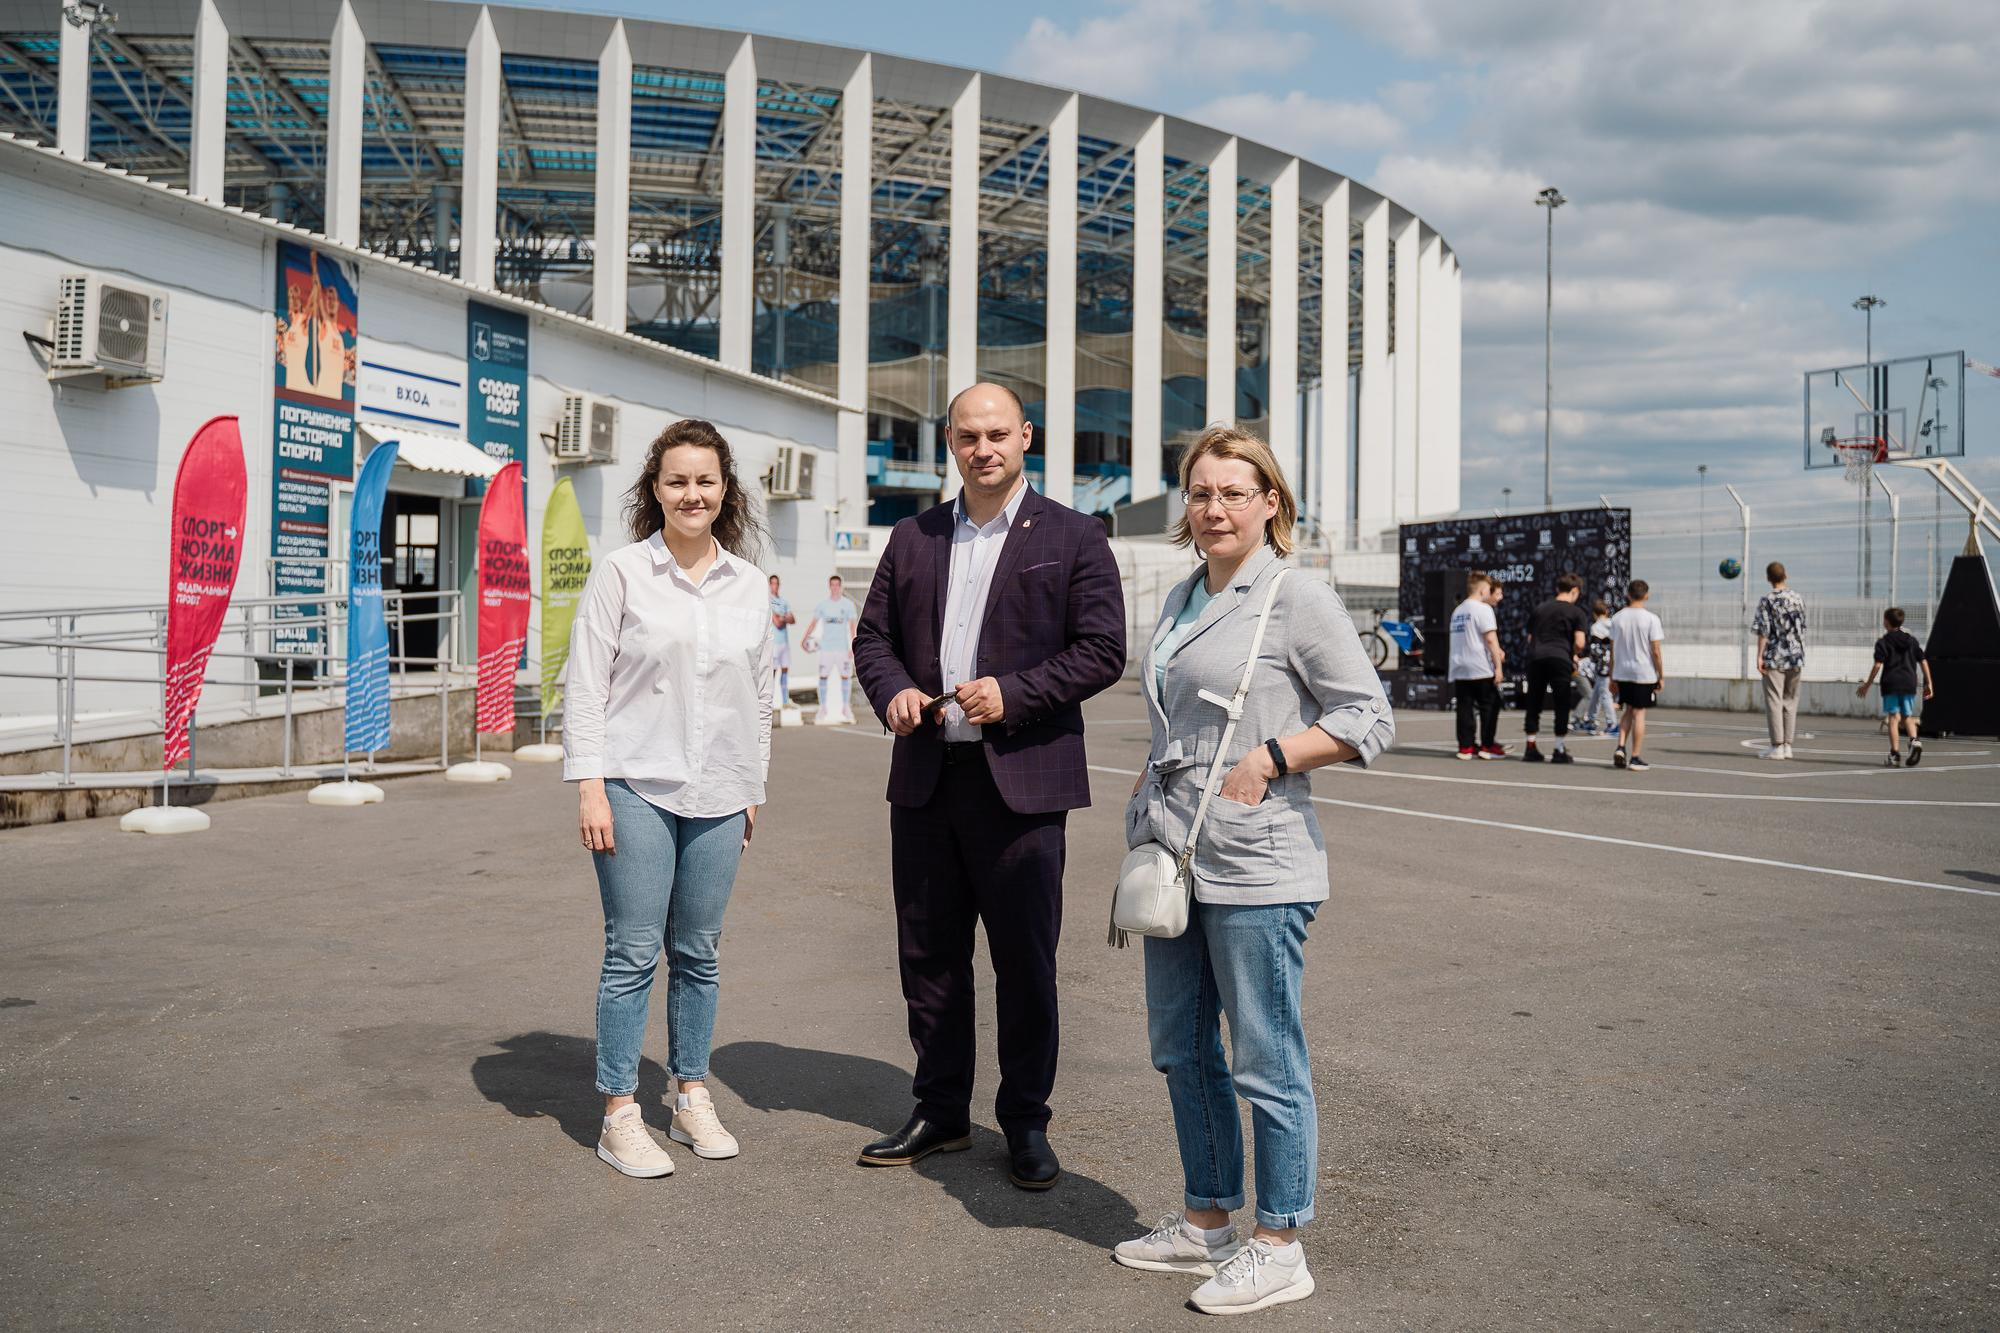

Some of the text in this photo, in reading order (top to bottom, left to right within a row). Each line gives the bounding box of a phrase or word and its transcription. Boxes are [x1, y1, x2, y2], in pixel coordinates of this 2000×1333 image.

[397, 386, 430, 407] ВХОД
[486, 395, 520, 415] ПОРТ
[280, 405, 352, 432] ПОГРУЖЕНИЕ
[280, 423, 342, 448] В ИСТОРИЮ
[279, 441, 322, 462] СПОРТА
[278, 492, 329, 506] НИЖЕГОРОДСКО
[182, 516, 227, 540] СПОРТ
[181, 538, 235, 563] НОРМА
[179, 559, 233, 584] ЖИЗНИ
